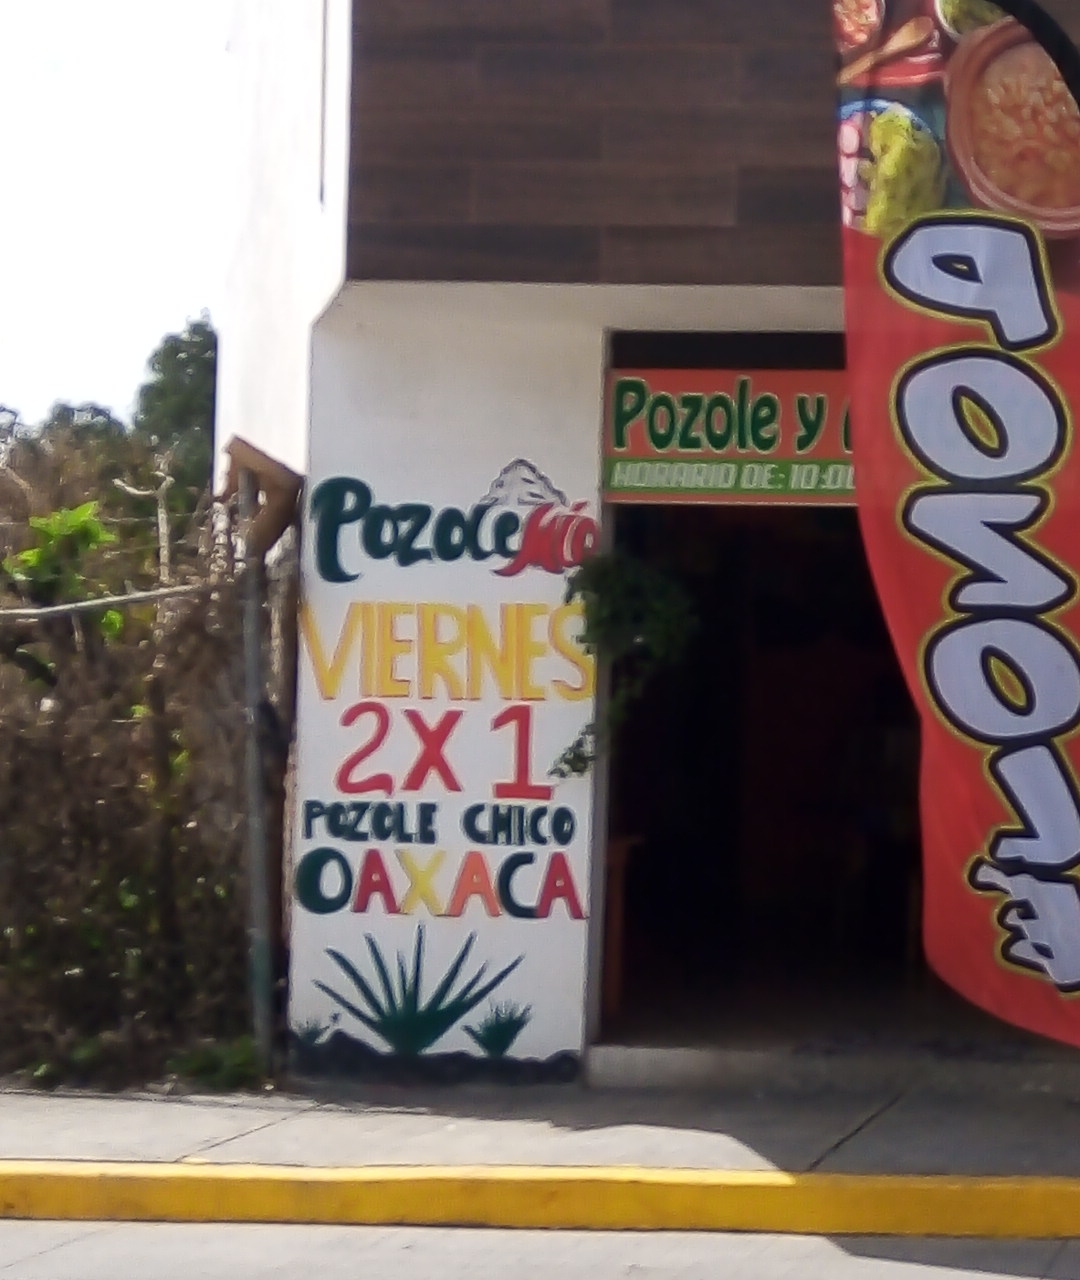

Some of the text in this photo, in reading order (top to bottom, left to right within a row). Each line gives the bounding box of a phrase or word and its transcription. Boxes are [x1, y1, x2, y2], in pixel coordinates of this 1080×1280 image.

[613, 376, 782, 455] Pozole
[796, 394, 827, 454] y
[300, 601, 596, 701] VIERNES
[303, 800, 576, 845] POZOLE CHICO
[297, 847, 587, 919] OAXACA
